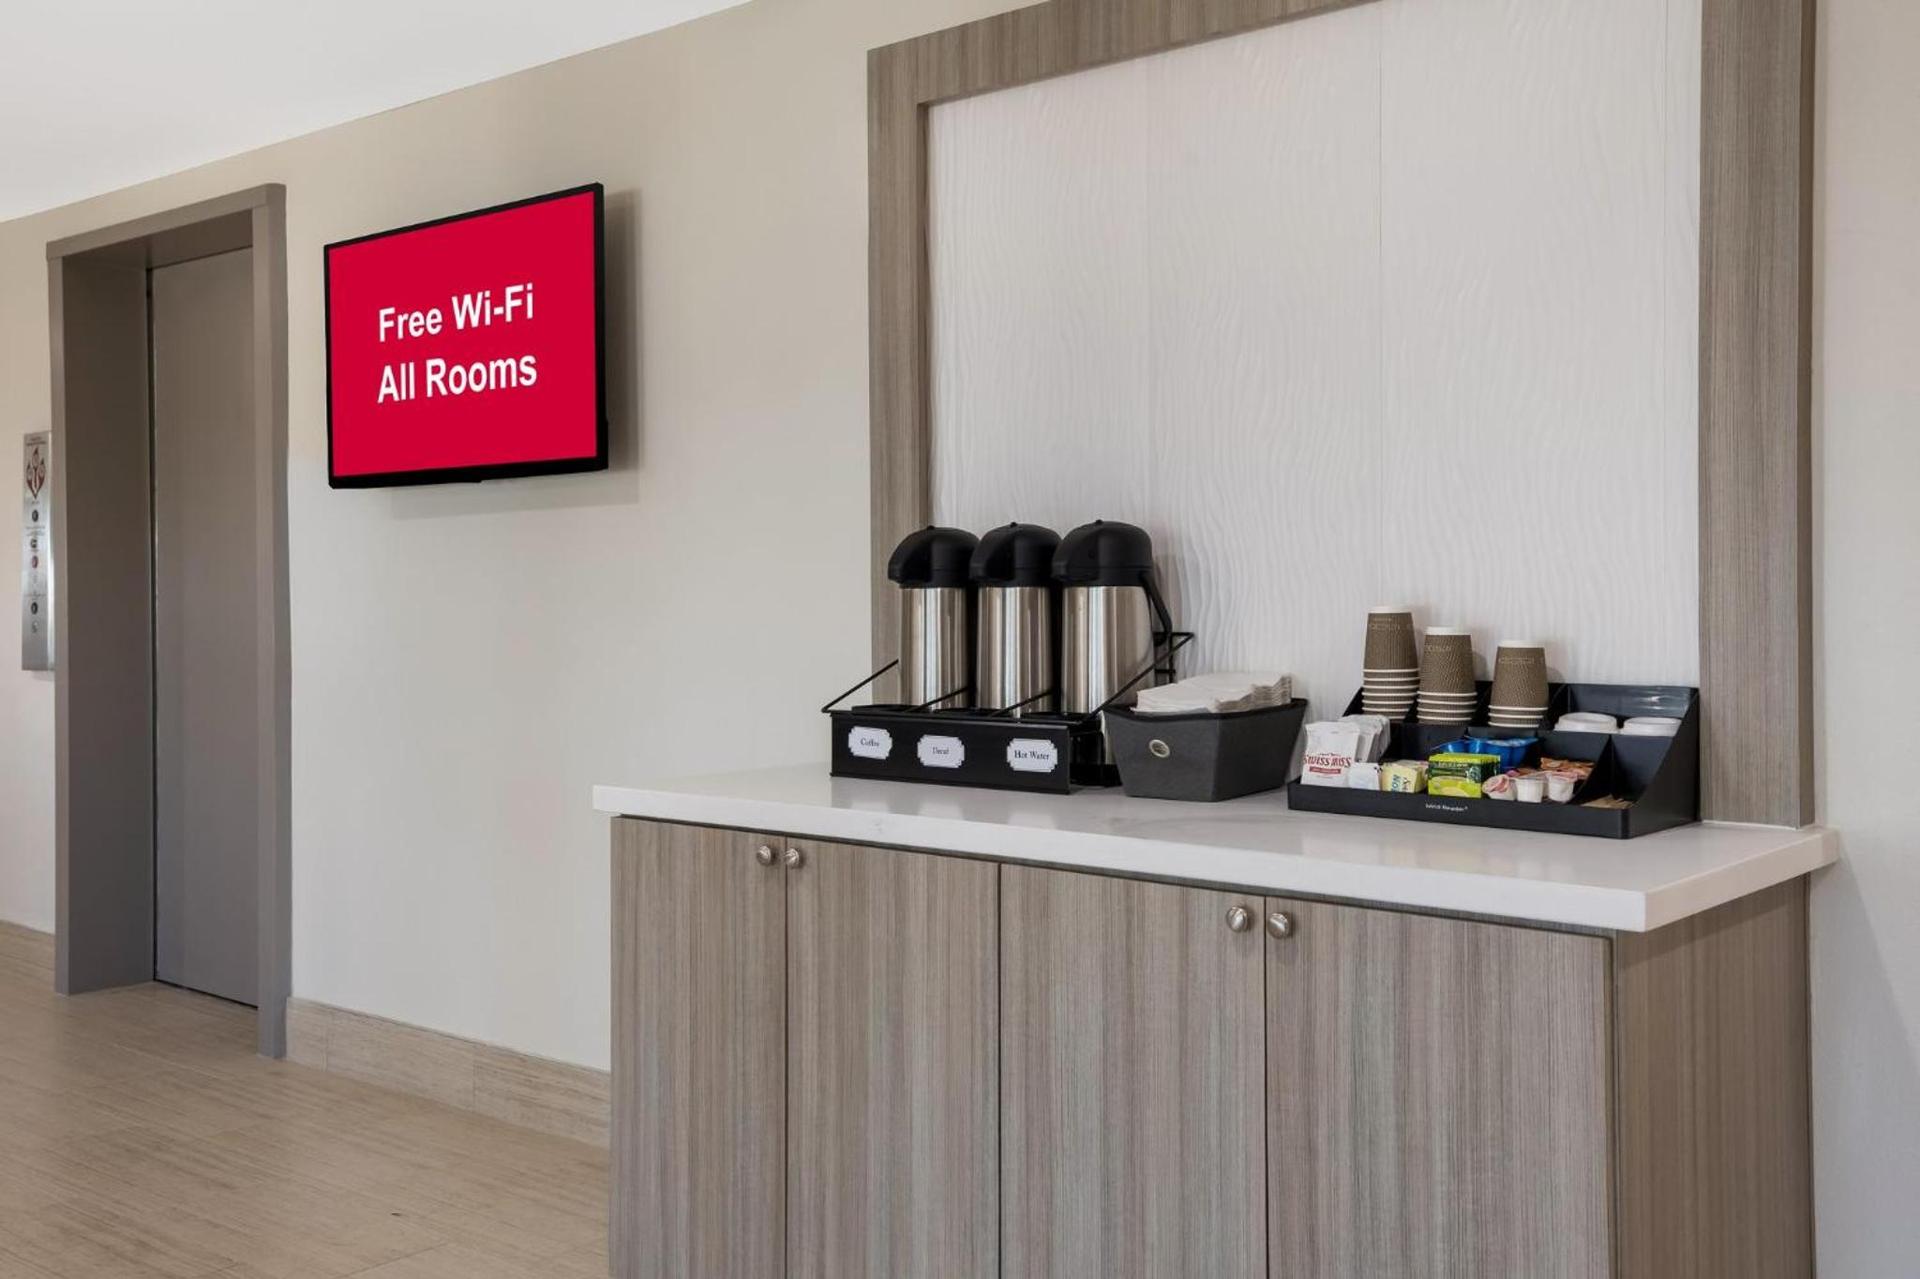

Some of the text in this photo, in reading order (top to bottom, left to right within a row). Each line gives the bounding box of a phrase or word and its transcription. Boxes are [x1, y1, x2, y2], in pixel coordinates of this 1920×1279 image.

[378, 283, 533, 342] Free Wi-Fi
[377, 355, 537, 403] All Rooms
[1014, 749, 1049, 760] Hot Water
